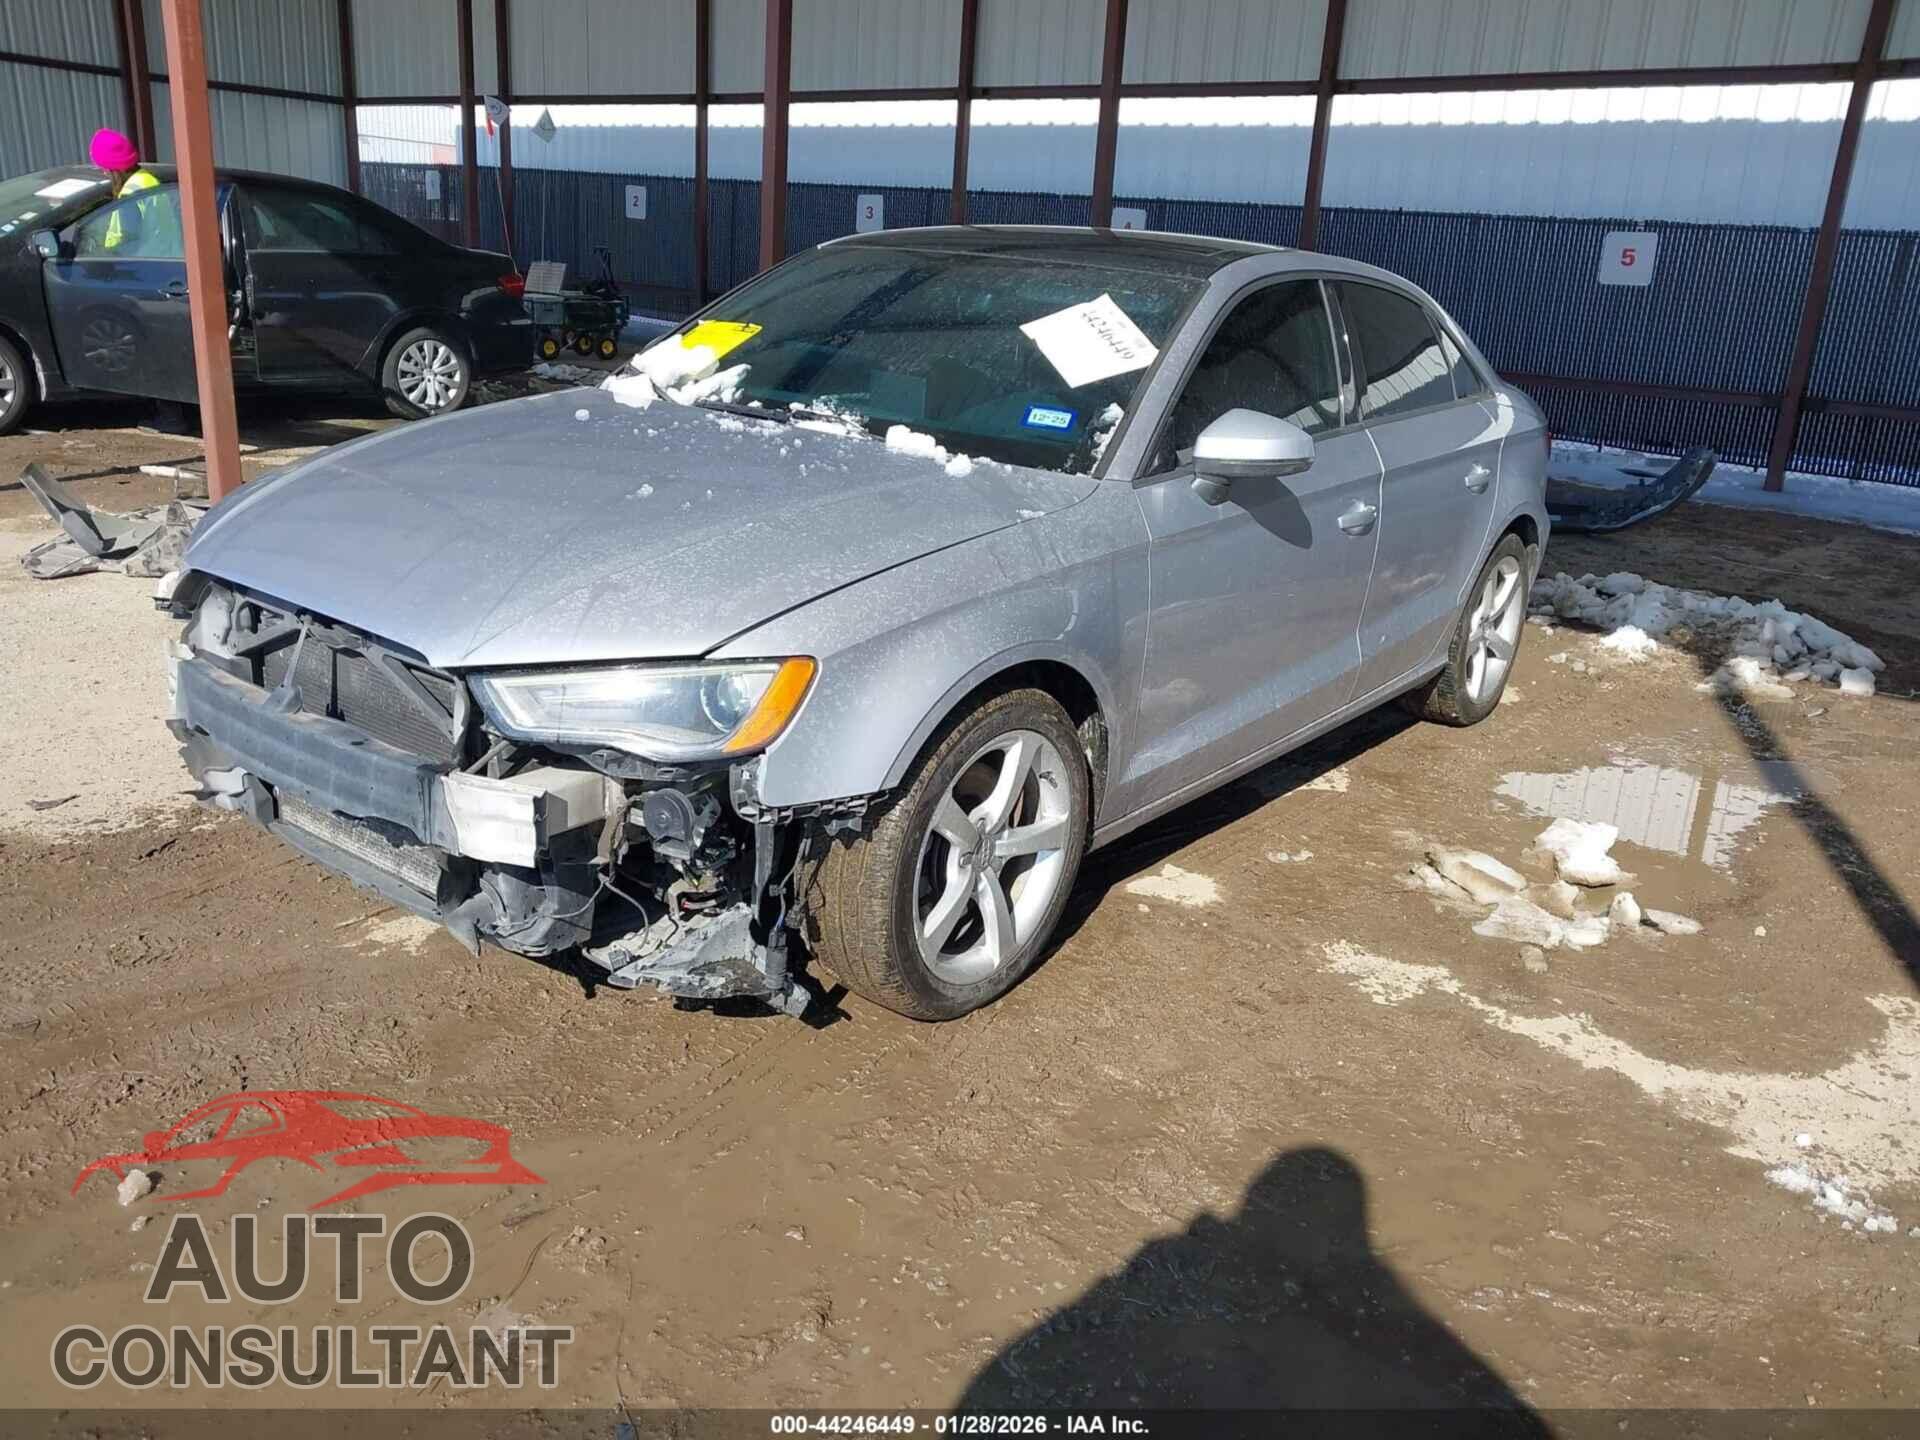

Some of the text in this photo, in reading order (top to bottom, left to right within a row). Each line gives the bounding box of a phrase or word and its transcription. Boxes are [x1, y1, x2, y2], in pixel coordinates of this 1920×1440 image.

[633, 195, 639, 207] 2
[865, 206, 874, 220] 3
[1620, 248, 1636, 267] 5
